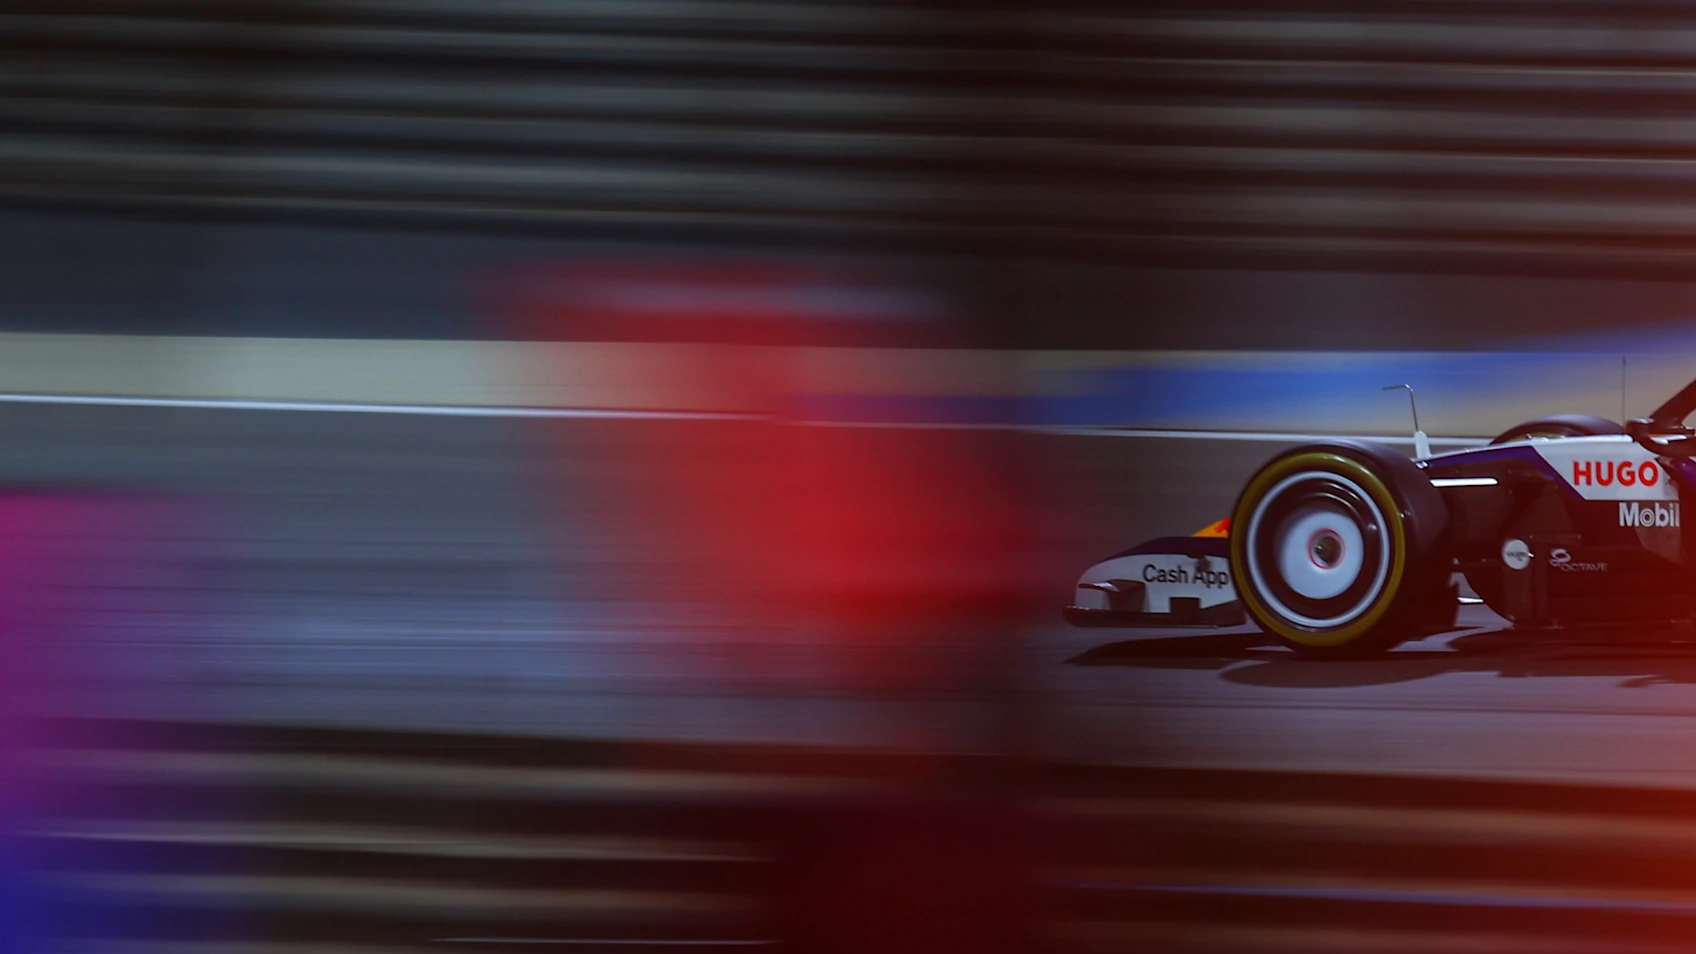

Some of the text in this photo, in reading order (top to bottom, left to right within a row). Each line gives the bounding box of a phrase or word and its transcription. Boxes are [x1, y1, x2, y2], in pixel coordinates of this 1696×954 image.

[1573, 461, 1659, 487] HUGO
[1618, 502, 1680, 527] Mobil
[1143, 564, 1229, 588] Cash App
[1560, 563, 1608, 572] OCTAVE
